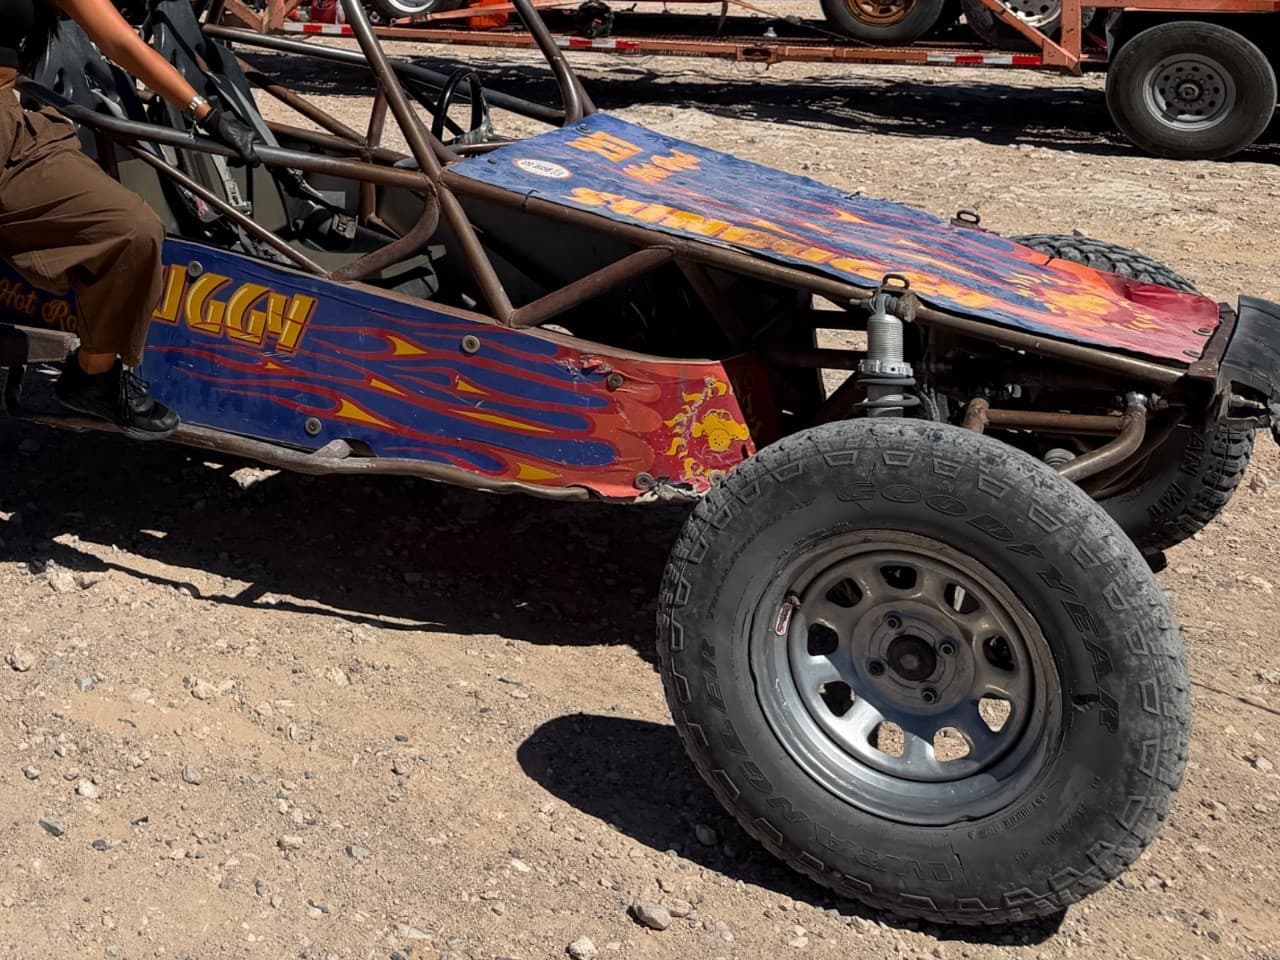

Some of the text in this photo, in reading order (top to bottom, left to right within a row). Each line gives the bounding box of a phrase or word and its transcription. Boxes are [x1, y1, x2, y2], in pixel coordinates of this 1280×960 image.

[42, 298, 78, 331] Ro
[152, 263, 318, 357] UGGY
[835, 483, 1121, 734] GOODYEAR
[702, 640, 955, 883] WRANGLER
